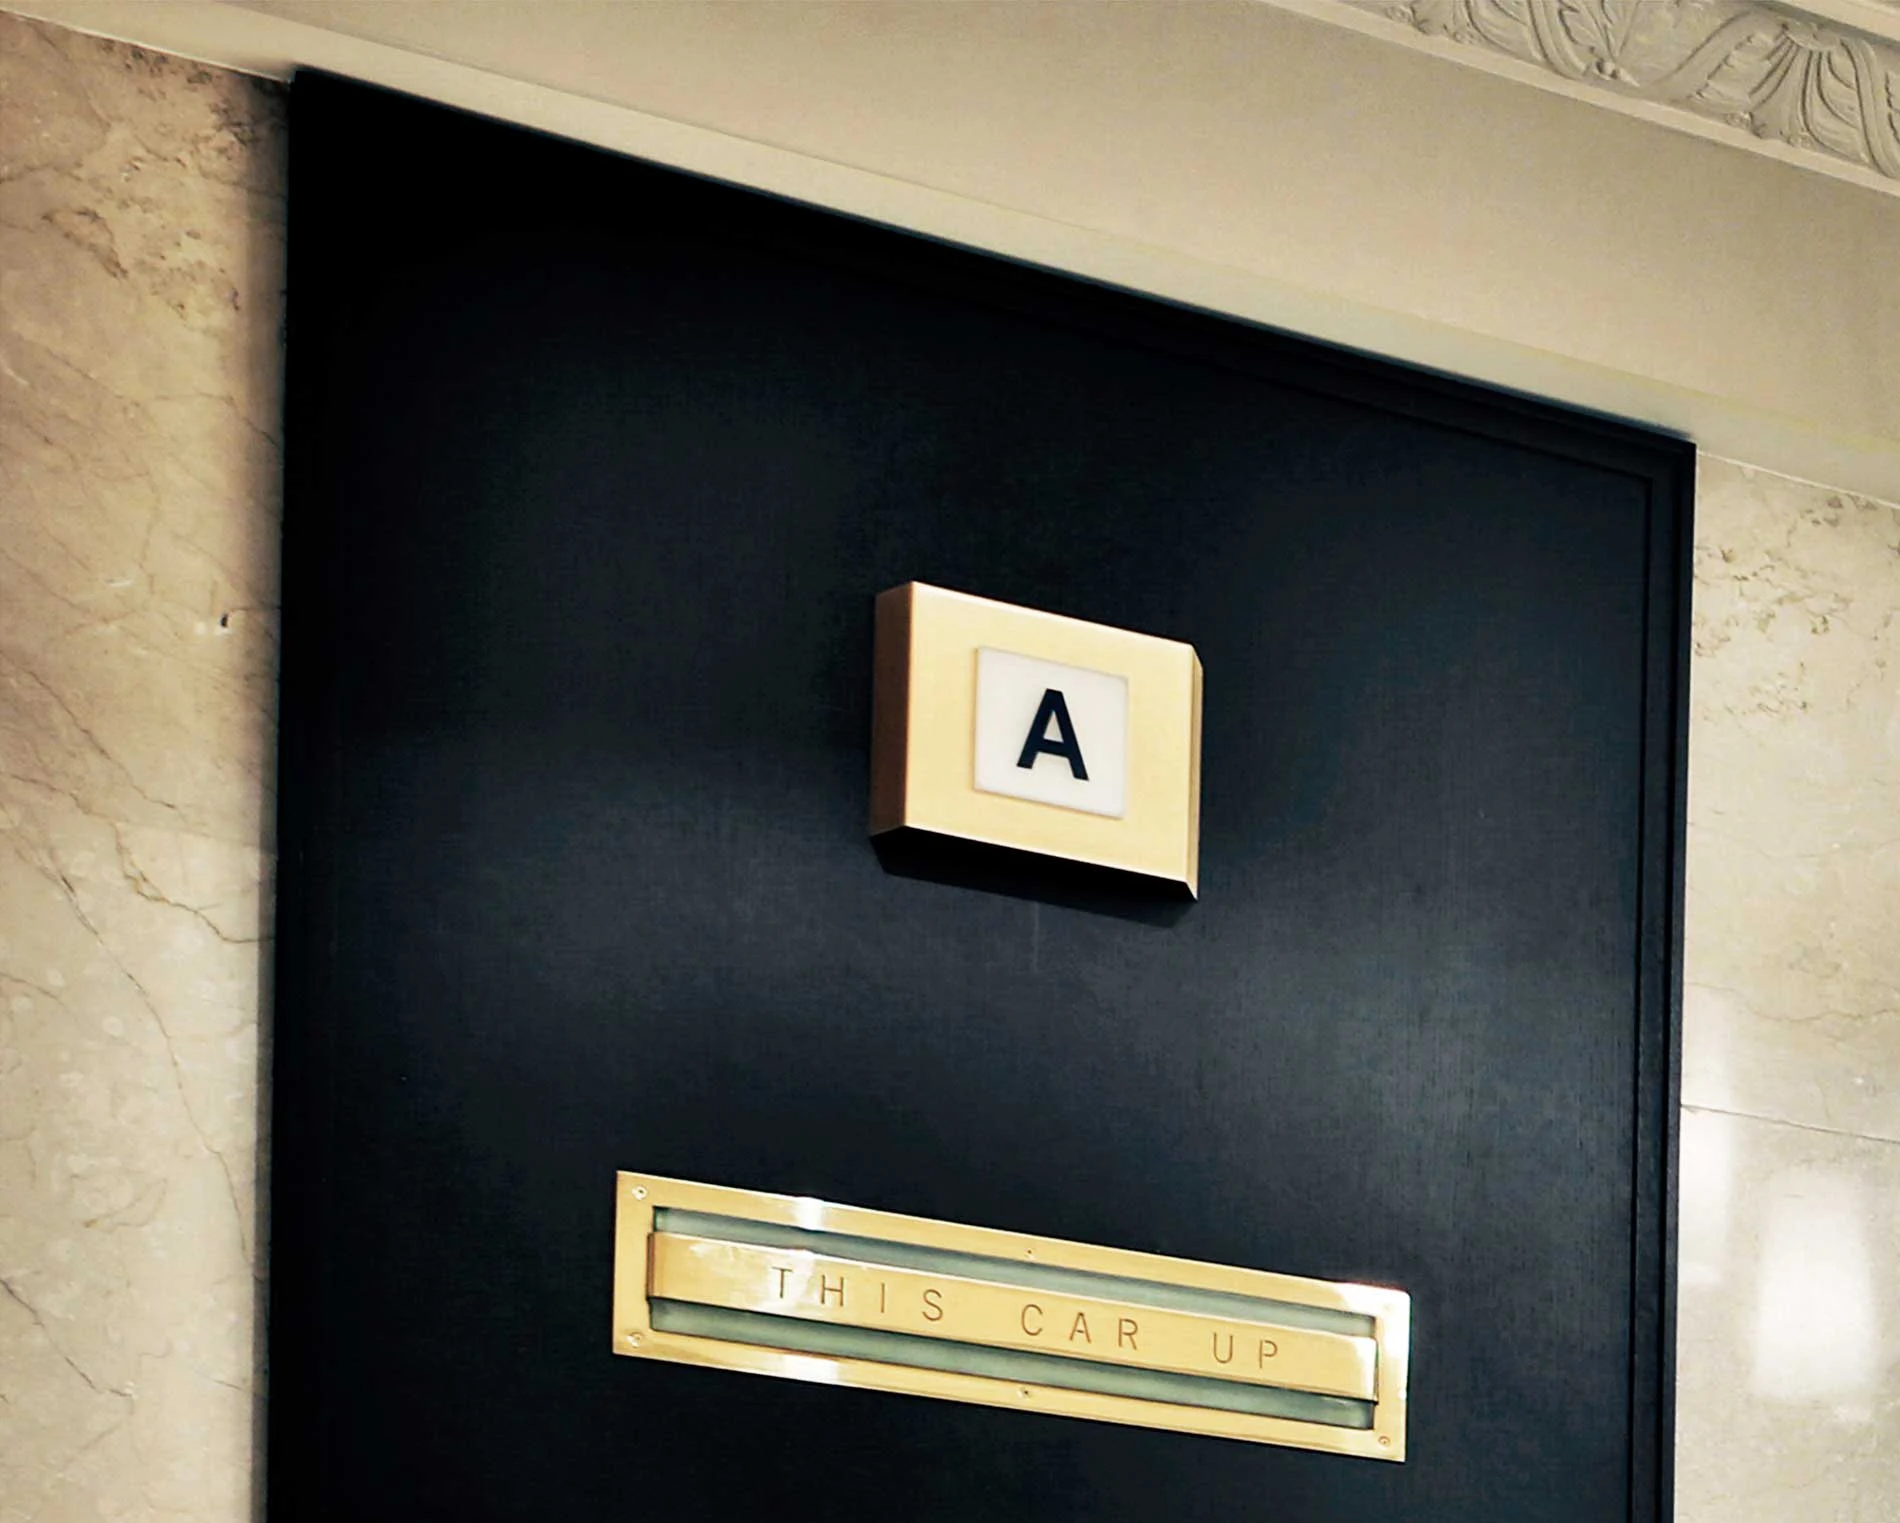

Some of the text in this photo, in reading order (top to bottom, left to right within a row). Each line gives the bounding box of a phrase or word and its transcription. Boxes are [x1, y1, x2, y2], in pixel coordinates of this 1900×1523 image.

[1016, 688, 1089, 781] A
[771, 1266, 1278, 1369] THIS CAR UP
